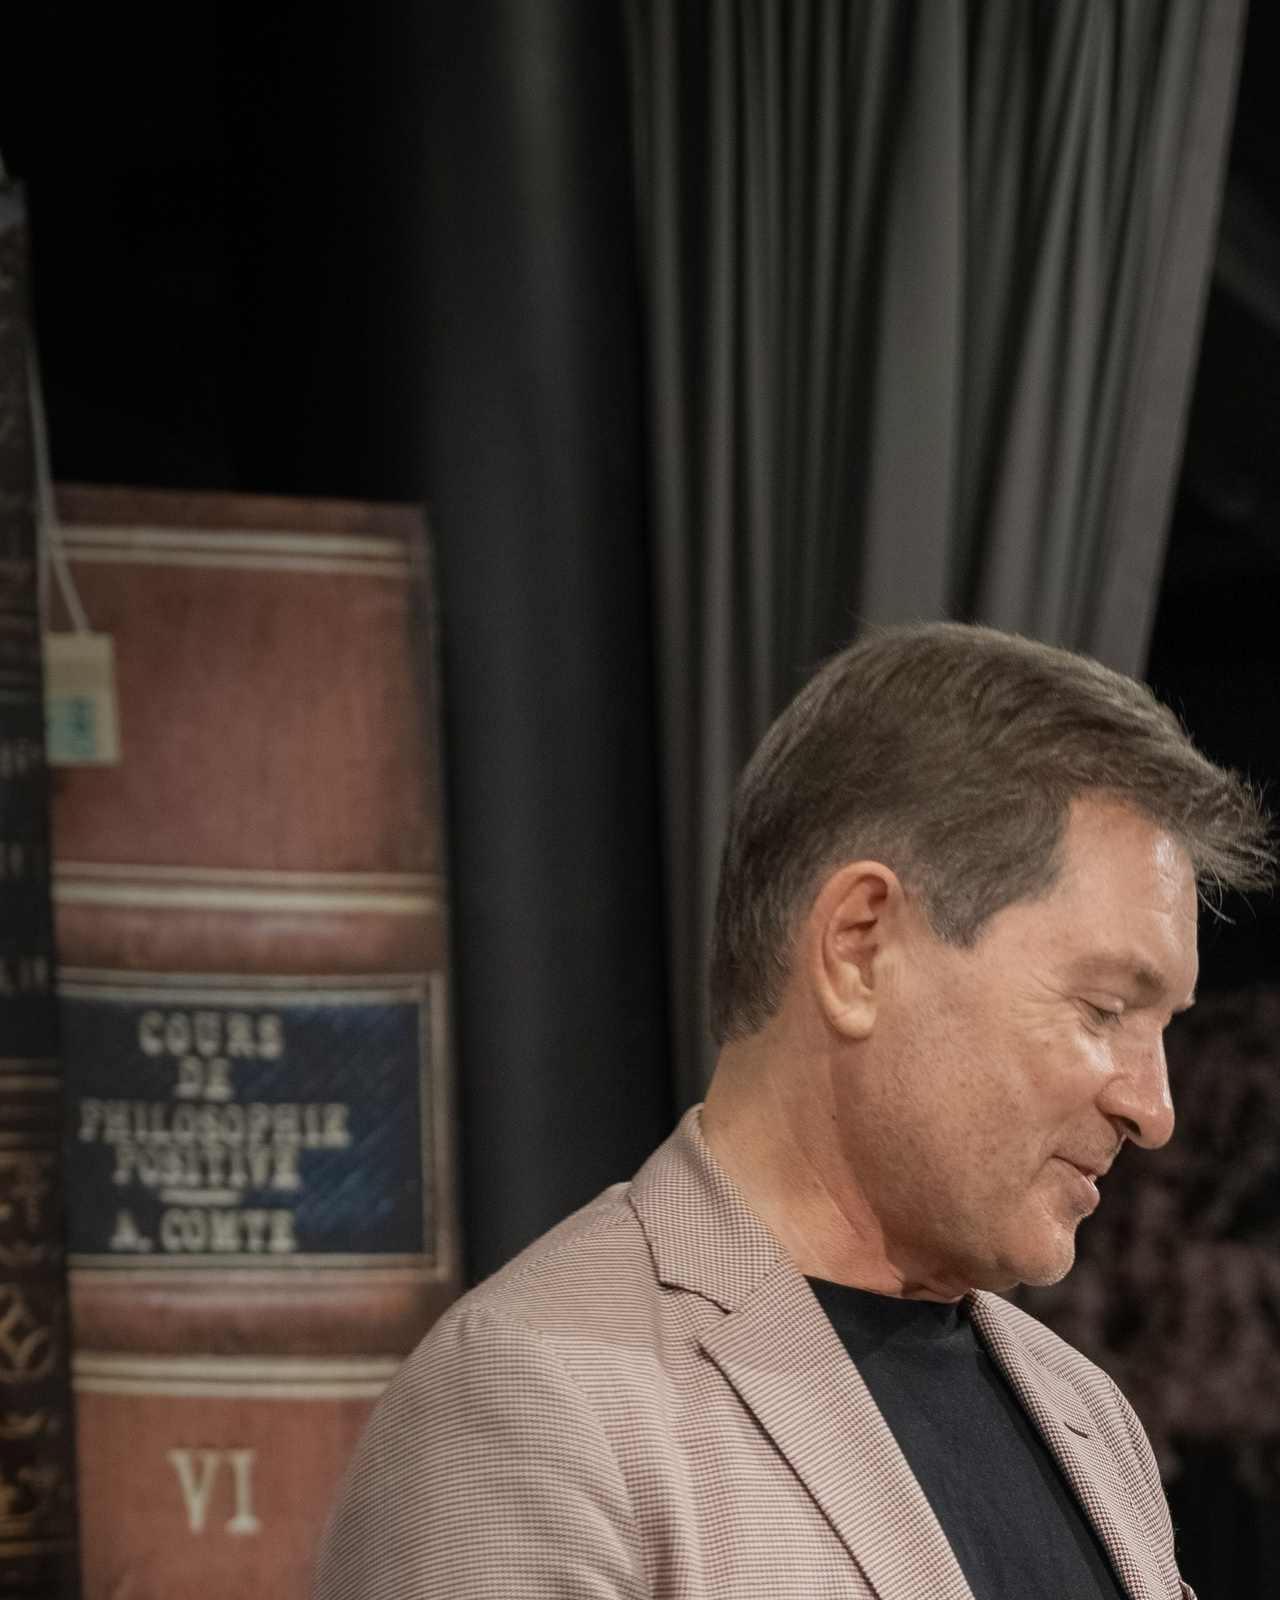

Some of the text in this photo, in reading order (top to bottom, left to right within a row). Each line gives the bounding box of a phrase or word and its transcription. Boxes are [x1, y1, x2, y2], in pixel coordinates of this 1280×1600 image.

[139, 1010, 284, 1058] COURS
[78, 1098, 351, 1148] PHILOSOPHIE
[160, 1208, 297, 1253] COMTE
[167, 1448, 262, 1535] VI
